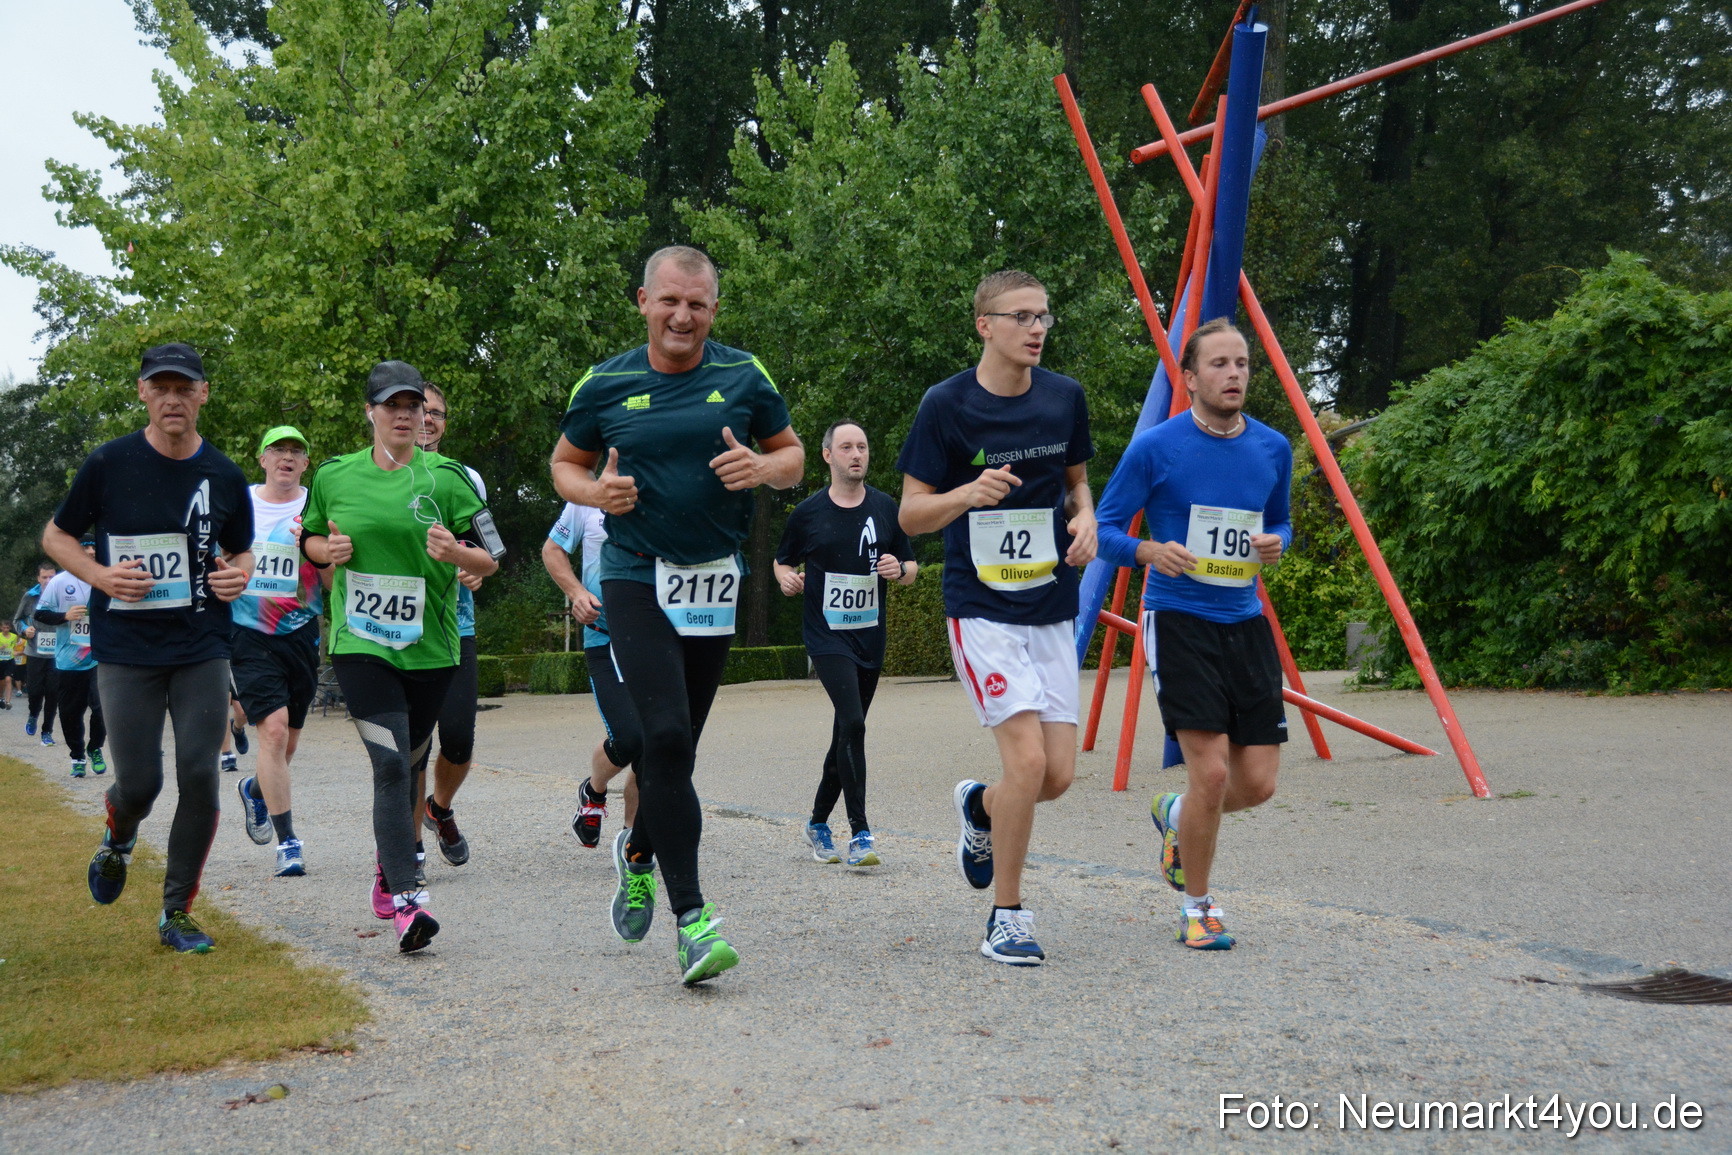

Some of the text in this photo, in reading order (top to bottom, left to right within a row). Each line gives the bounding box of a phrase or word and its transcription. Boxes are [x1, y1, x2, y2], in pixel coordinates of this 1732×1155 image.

[986, 449, 1023, 465] GOSSEN
[1010, 512, 1046, 522] BOCK
[140, 536, 179, 547] BOCK
[1000, 530, 1032, 560] 42
[1206, 526, 1251, 558] 196
[256, 555, 294, 577] 410
[1206, 562, 1244, 577] Bastian
[1001, 568, 1034, 580] Oliver
[255, 579, 278, 590] Erwin
[379, 577, 418, 589] BOCK
[667, 573, 735, 604] 2112
[355, 589, 417, 621] 2245
[829, 587, 875, 609] 2601
[686, 612, 714, 626] Georg
[843, 614, 862, 623] Ryan
[987, 681, 1005, 693] FCN
